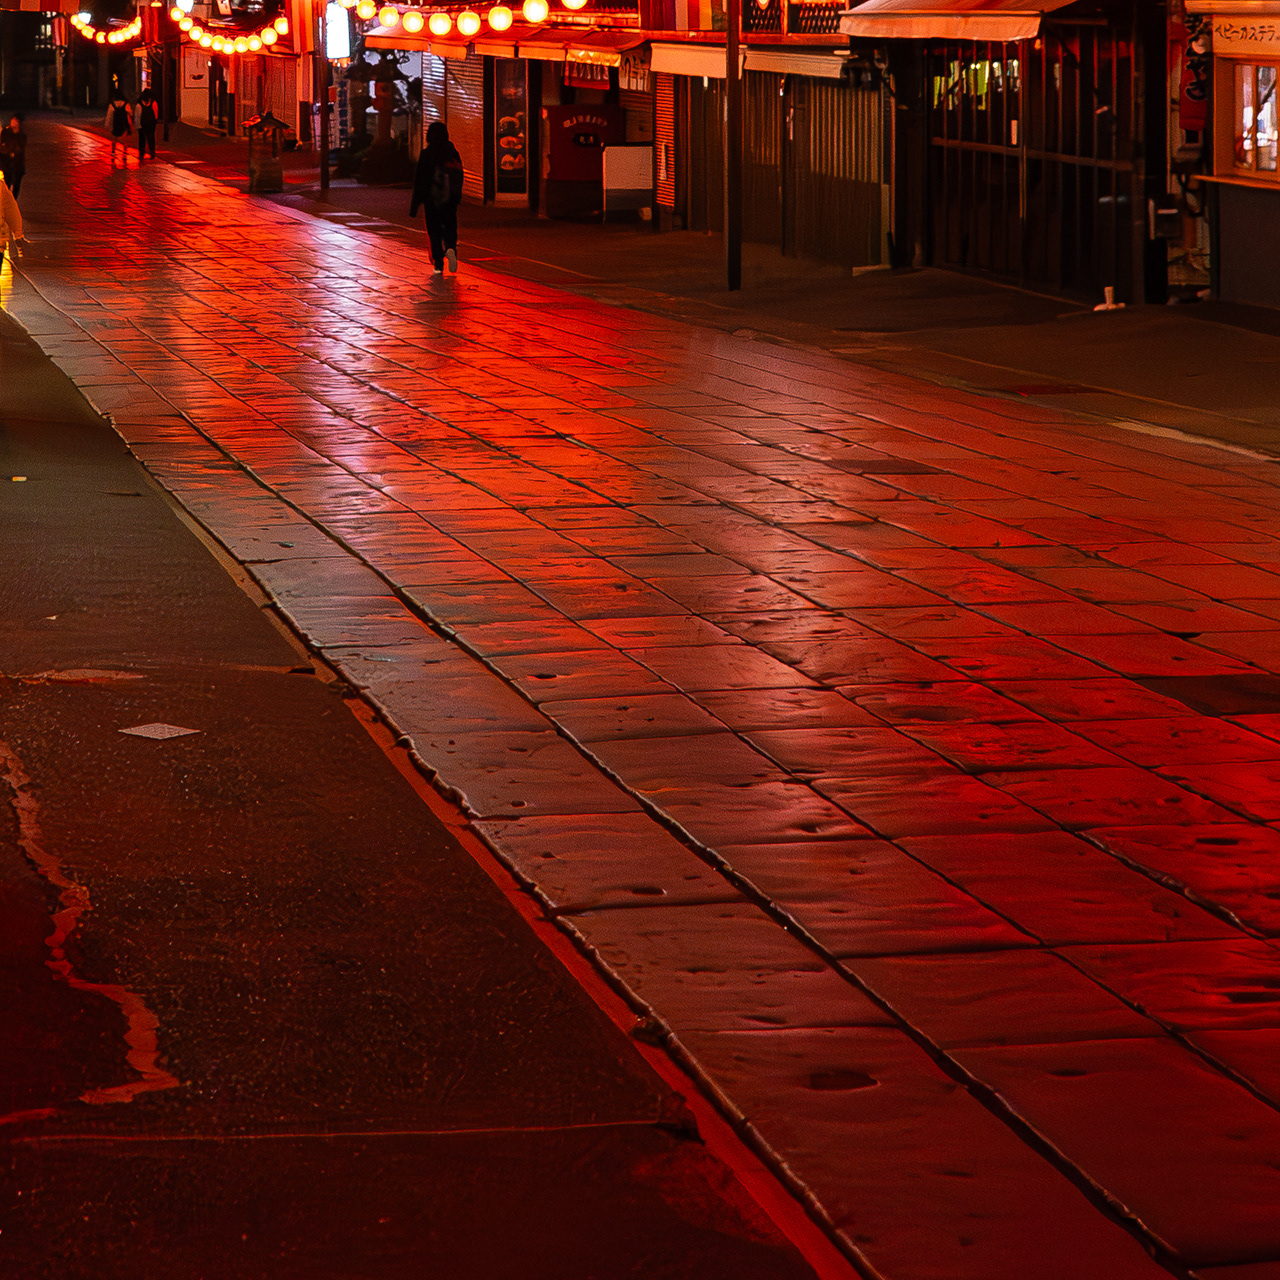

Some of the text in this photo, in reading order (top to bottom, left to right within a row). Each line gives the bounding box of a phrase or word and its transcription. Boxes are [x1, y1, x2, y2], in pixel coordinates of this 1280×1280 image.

[1214, 23, 1277, 42] ベビーカステラ
